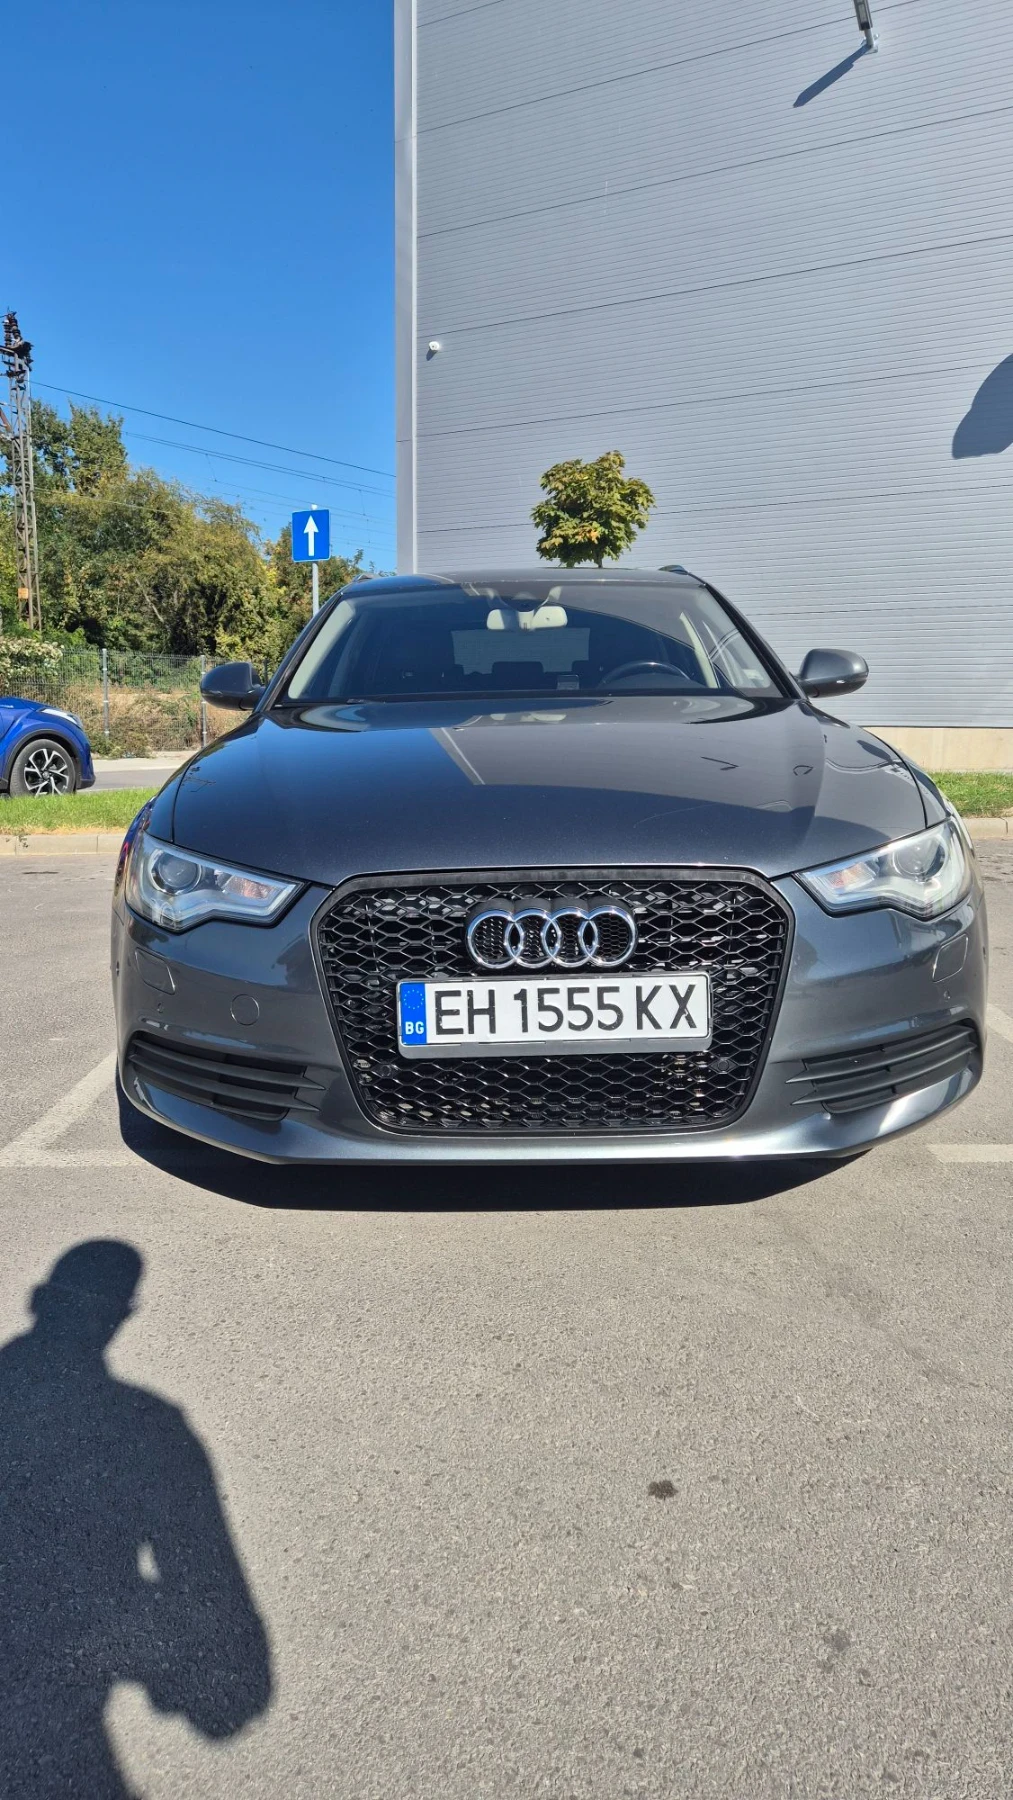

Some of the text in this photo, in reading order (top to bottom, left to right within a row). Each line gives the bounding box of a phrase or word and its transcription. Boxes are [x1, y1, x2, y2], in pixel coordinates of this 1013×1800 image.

[434, 984, 697, 1035] EH 1555 KX
[405, 1021, 424, 1034] BG
